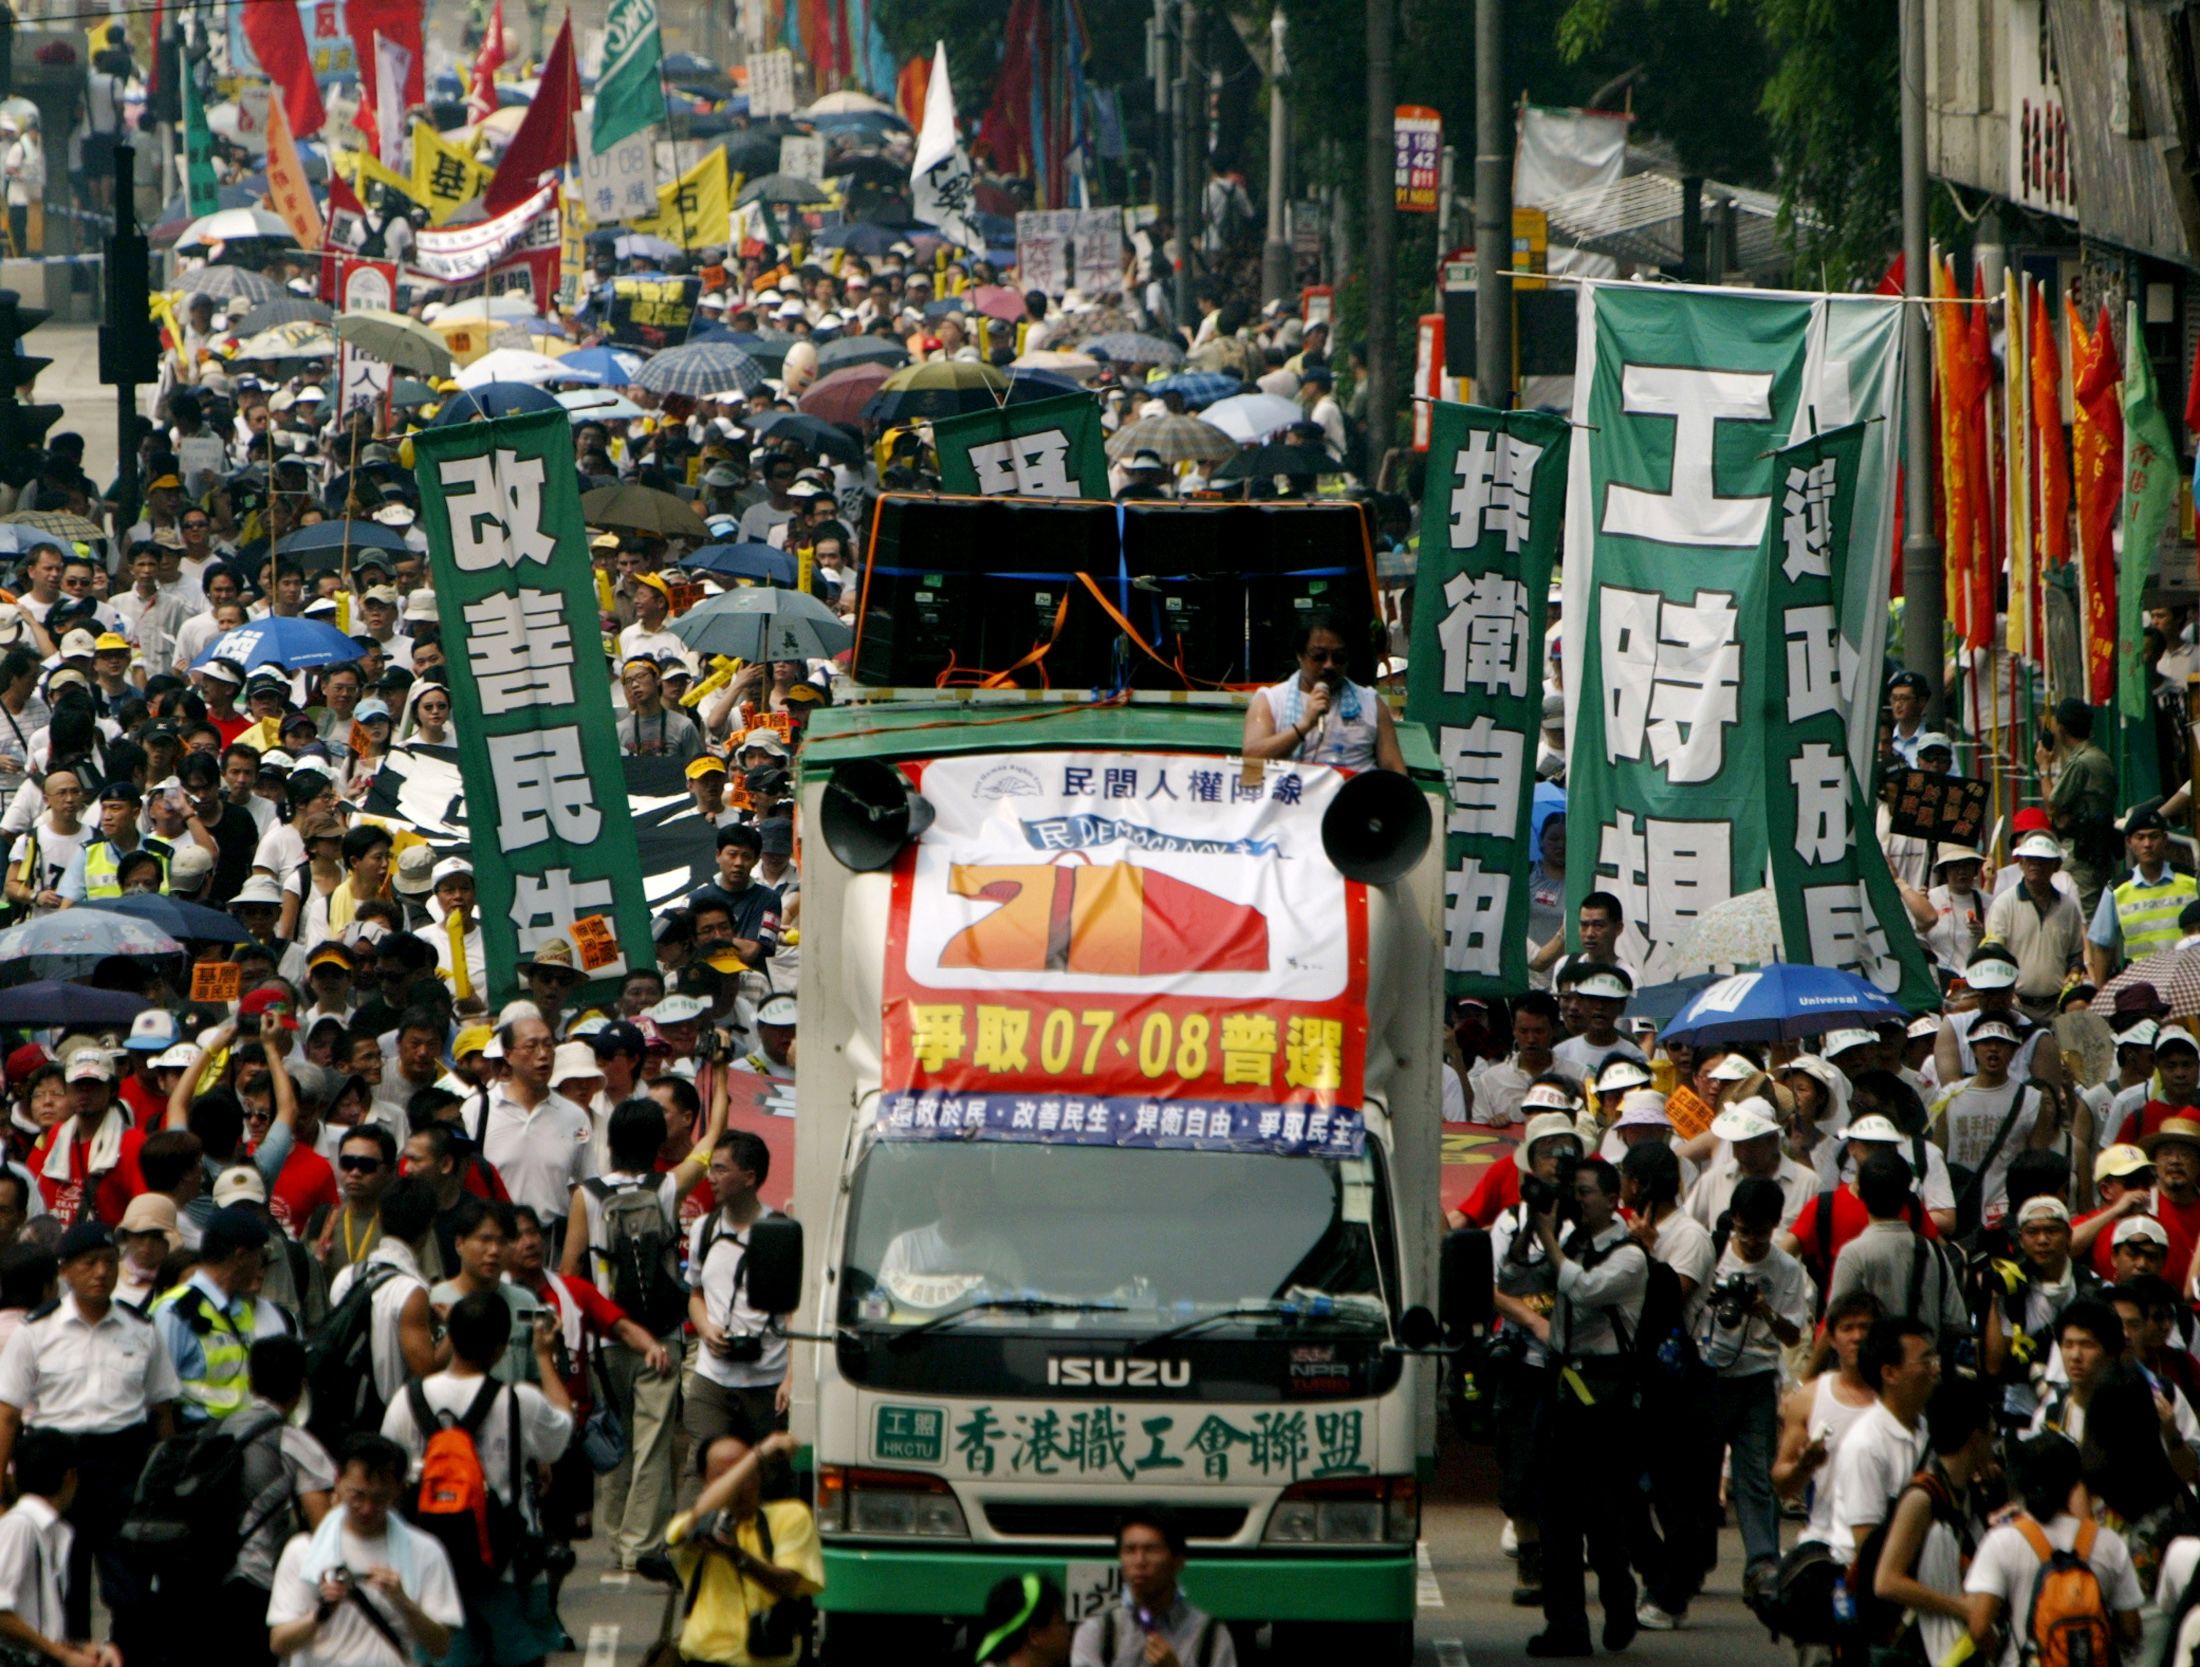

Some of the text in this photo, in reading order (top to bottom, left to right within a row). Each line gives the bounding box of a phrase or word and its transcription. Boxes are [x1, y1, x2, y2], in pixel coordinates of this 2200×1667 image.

[1441, 430, 1543, 977] 捍衛自由
[439, 449, 627, 991] 改善民生
[1799, 993, 1859, 1007] Universal
[1047, 1357, 1191, 1388] ISUZU
[1289, 1364, 1350, 1377] NPR
[884, 1410, 937, 1437] 工盟
[883, 1440, 935, 1458] HKCTU
[955, 1404, 1371, 1482] 香港職工會聯盟
